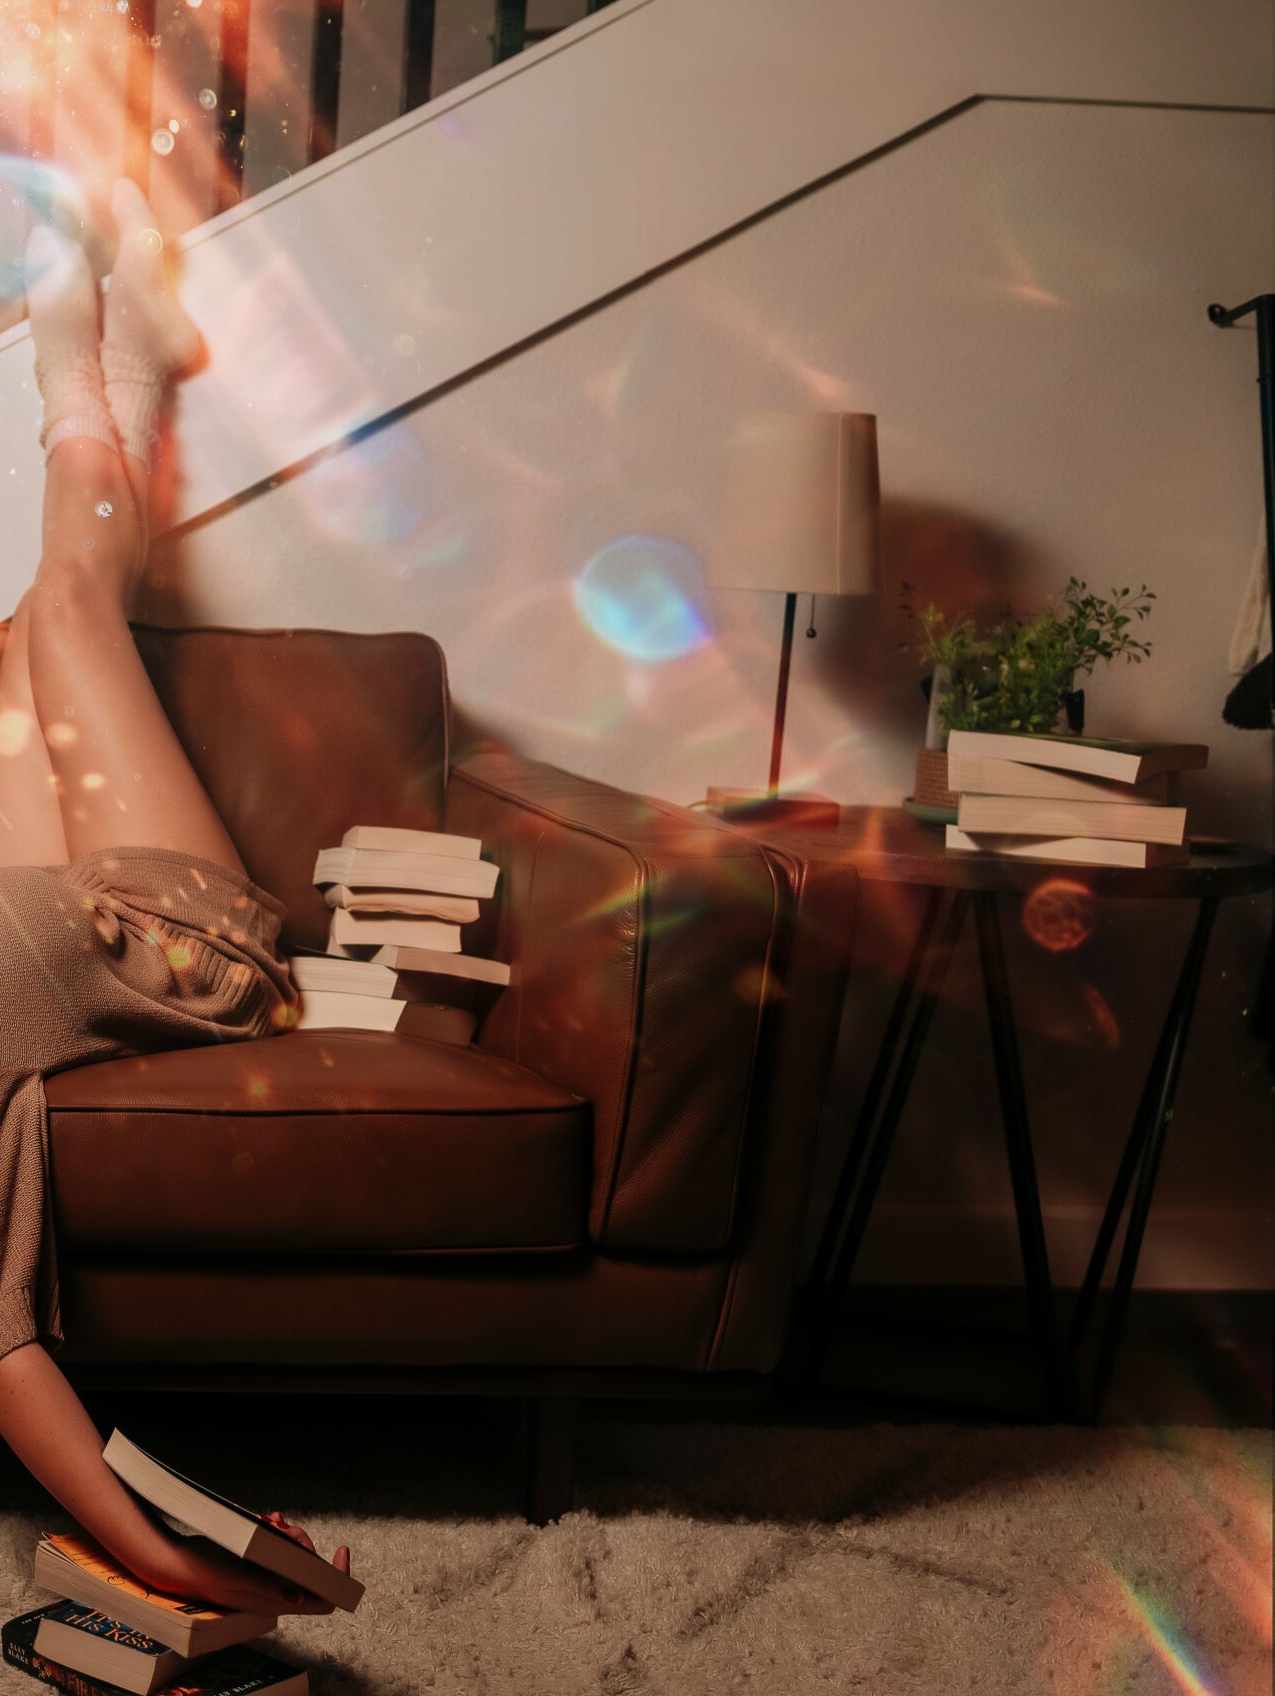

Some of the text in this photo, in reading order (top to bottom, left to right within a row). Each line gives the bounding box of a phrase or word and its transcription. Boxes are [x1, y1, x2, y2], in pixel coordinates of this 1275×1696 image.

[65, 1614, 154, 1649] HIS KISS
[7, 1648, 29, 1665] BLAKE
[9, 1642, 26, 1656] ELLY
[232, 1679, 262, 1693] BLAKE
